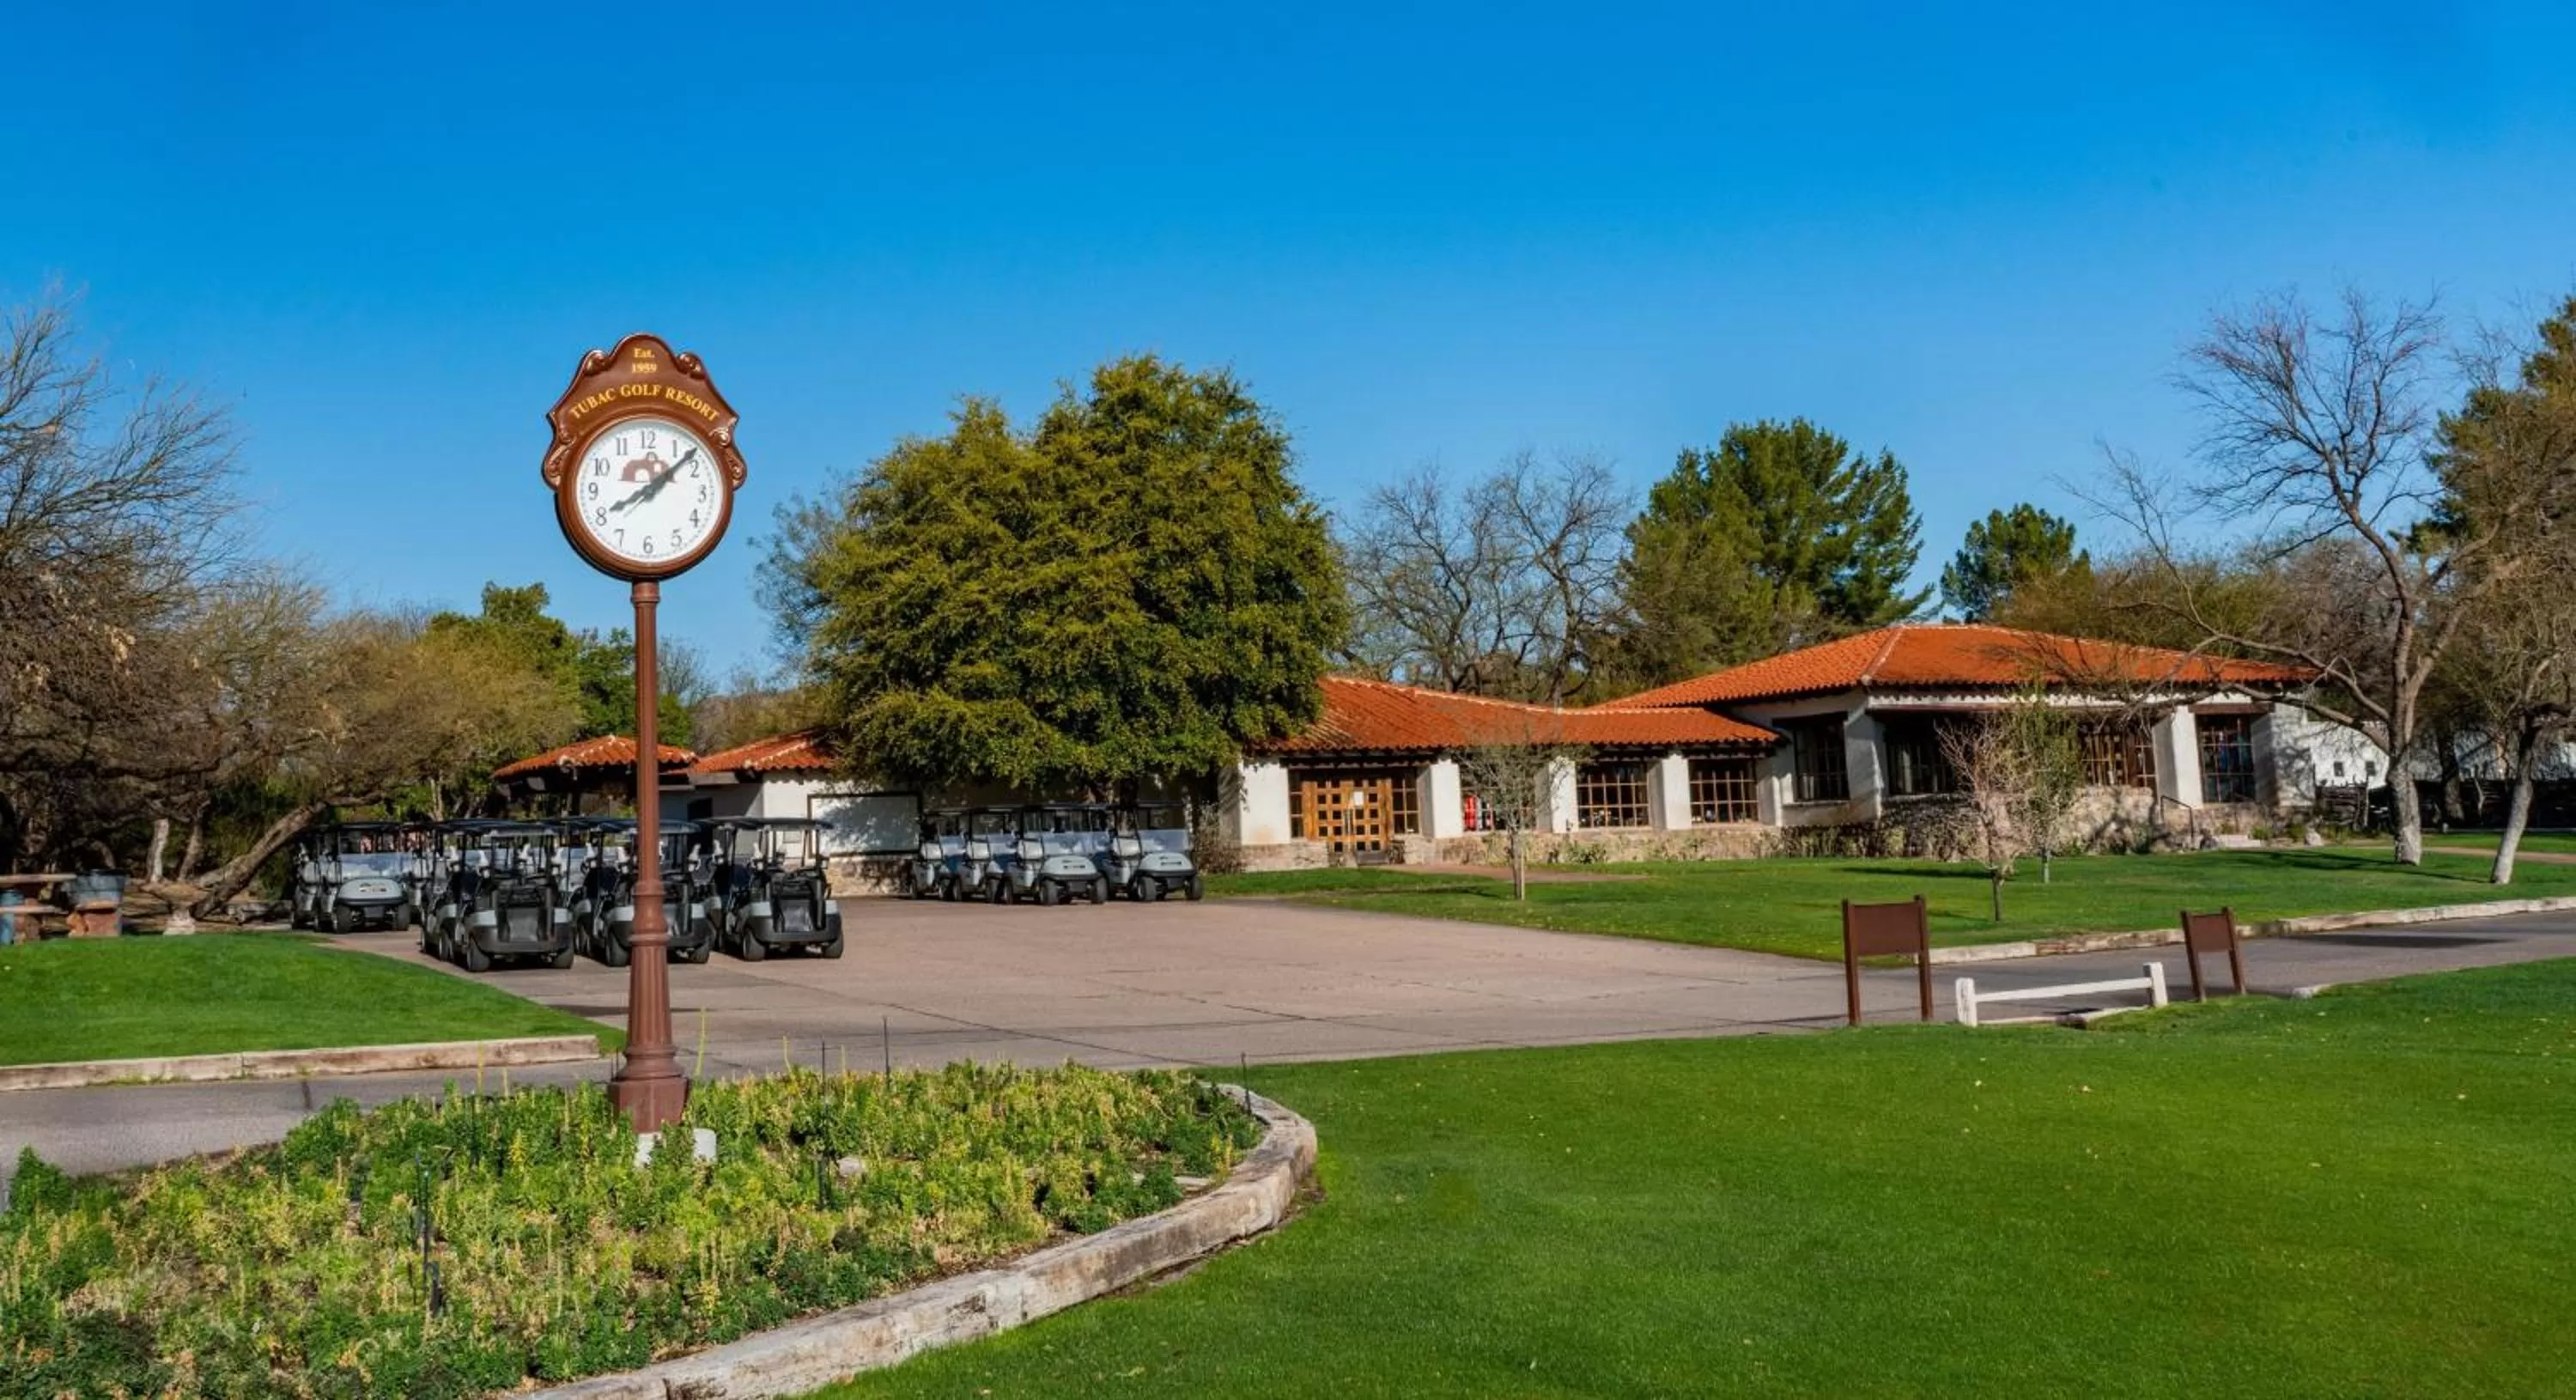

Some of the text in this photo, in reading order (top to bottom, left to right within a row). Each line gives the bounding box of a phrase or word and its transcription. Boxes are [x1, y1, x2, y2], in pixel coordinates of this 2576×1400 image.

[633, 348, 655, 359] Est.
[570, 384, 720, 422] TUBAC GOLF RESORT
[615, 437, 629, 456] 11
[639, 431, 656, 449] 12
[672, 439, 678, 458] 1
[593, 457, 610, 477] 10
[690, 460, 700, 478] 2
[588, 482, 598, 501] 9
[697, 484, 707, 503] 3
[596, 507, 607, 527] 8
[689, 508, 700, 528] 4
[614, 528, 625, 547] 7
[643, 536, 653, 554] 6
[671, 529, 683, 547] 5
